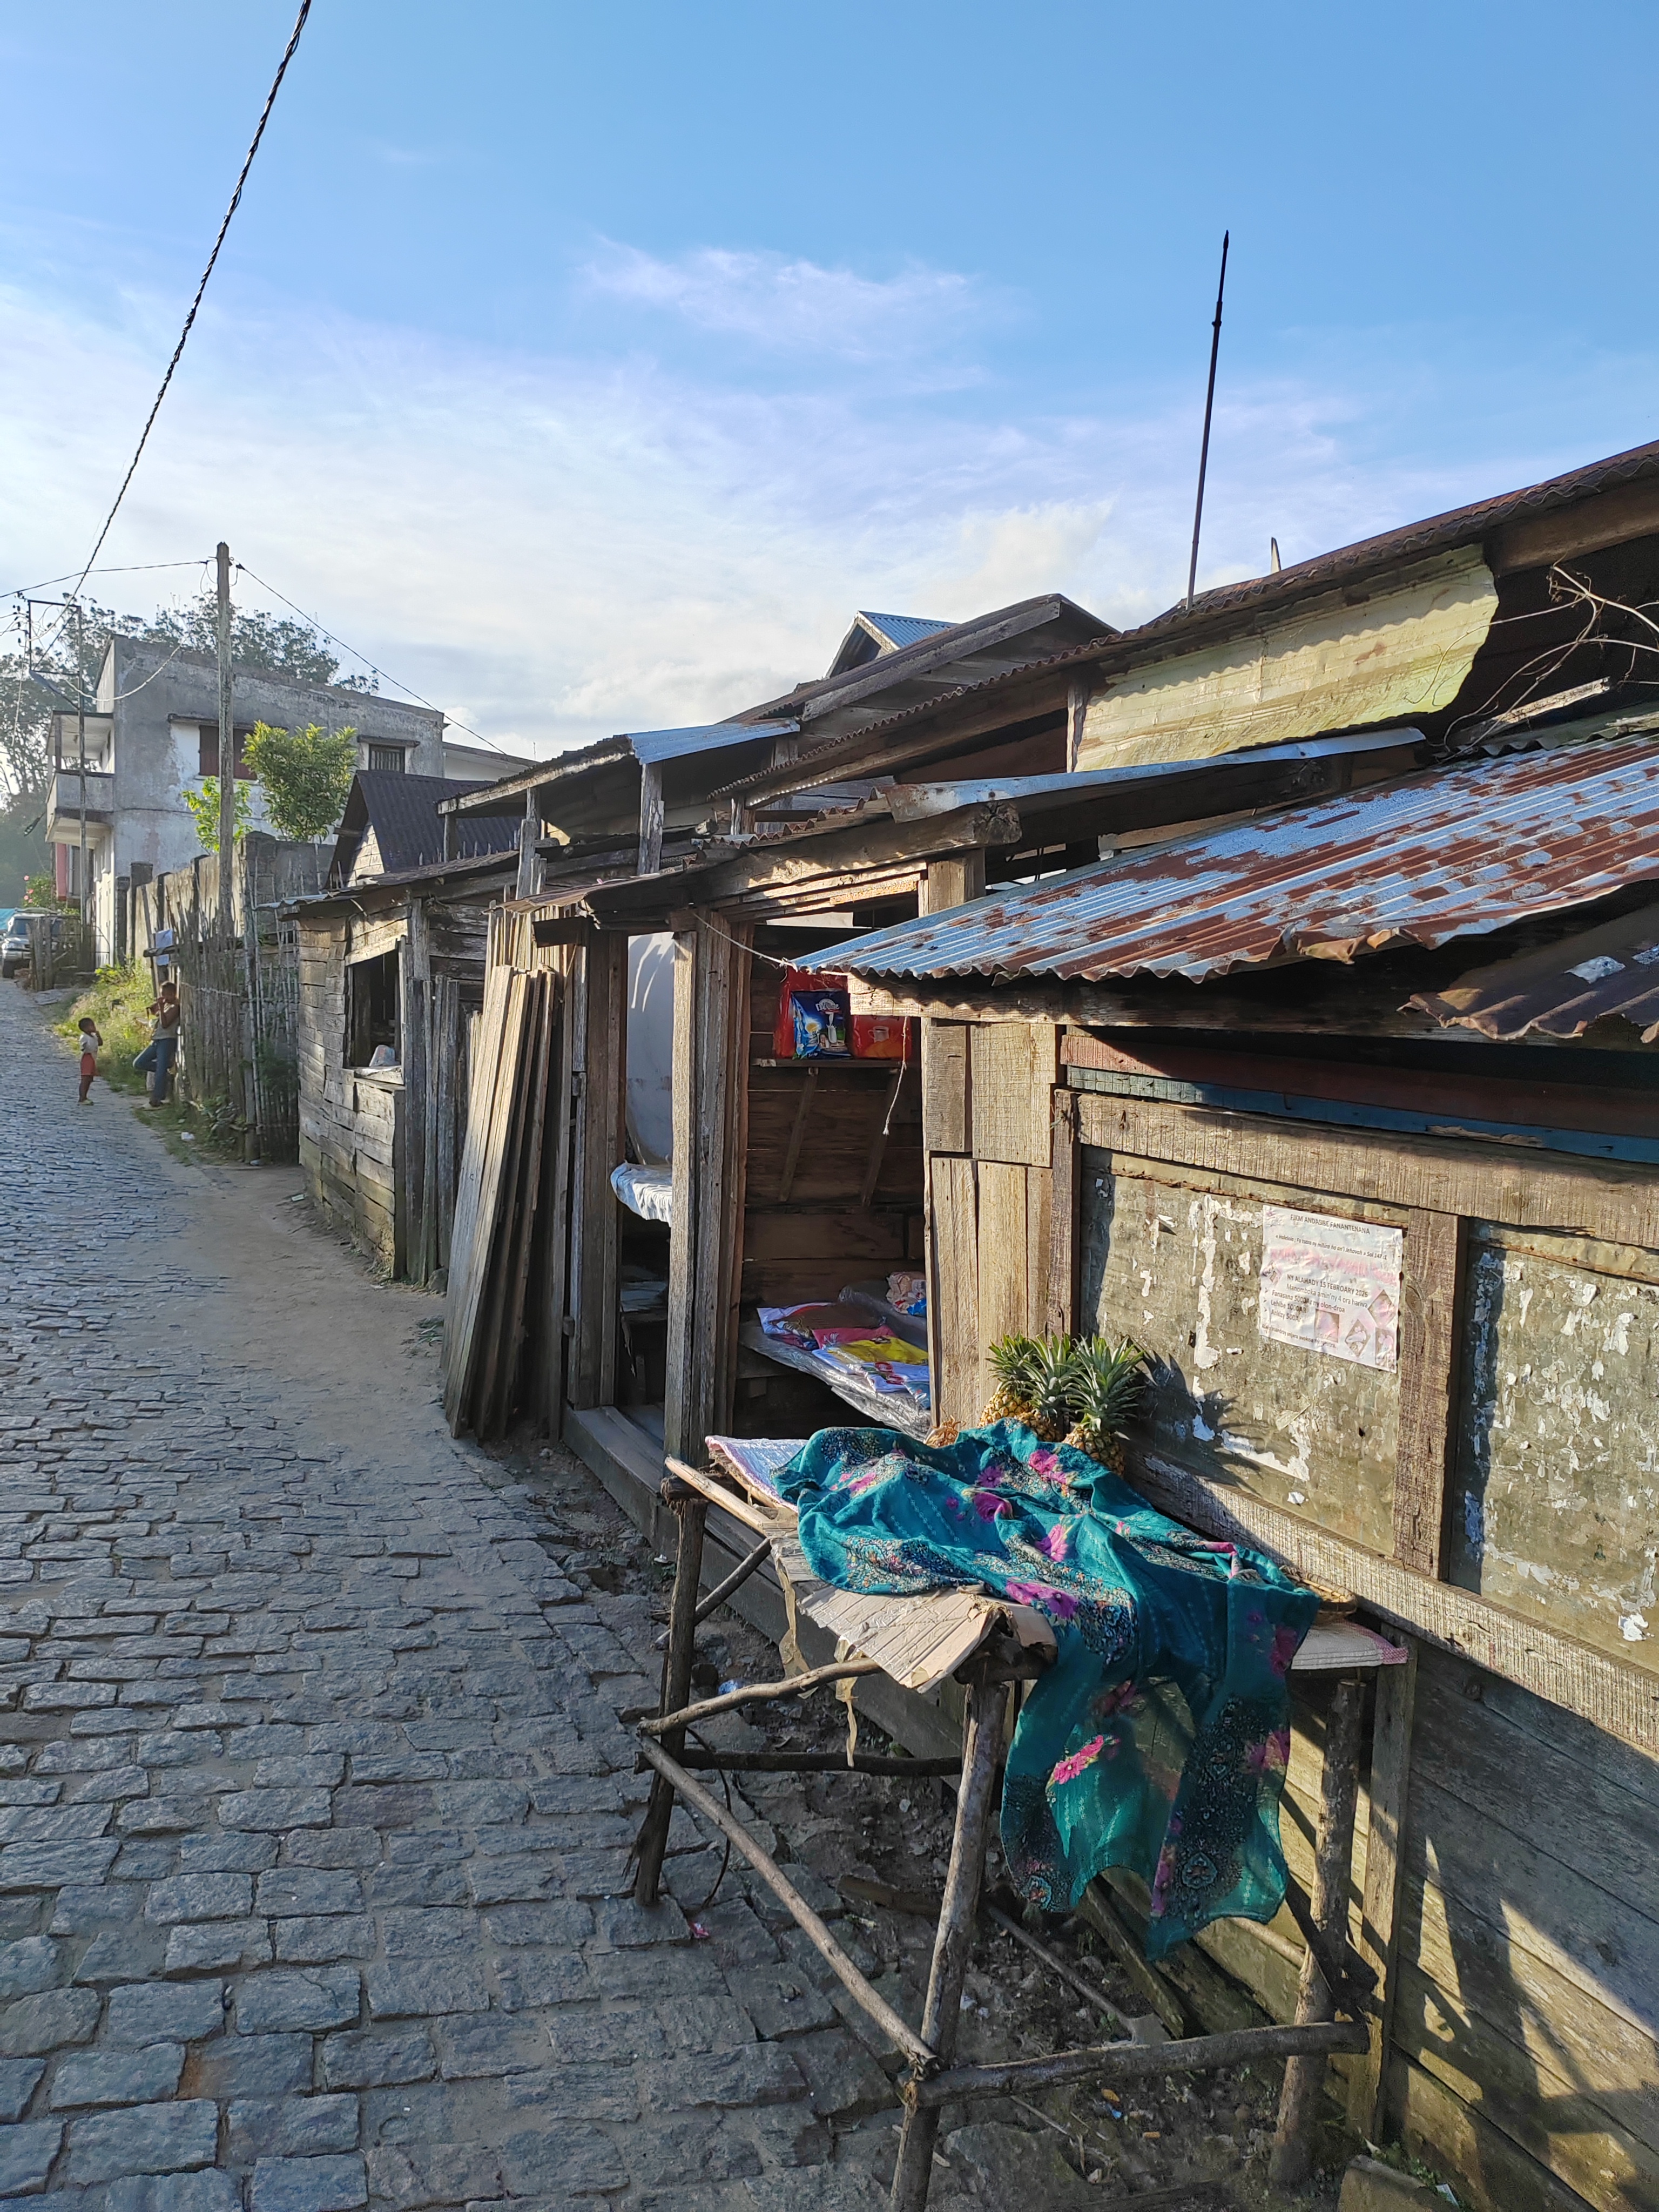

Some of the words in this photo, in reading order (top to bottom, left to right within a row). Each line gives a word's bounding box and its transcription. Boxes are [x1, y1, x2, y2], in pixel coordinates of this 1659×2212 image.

[1304, 1217, 1328, 1226] ANDASIBE
[1330, 1222, 1370, 1234] FANANTENANA
[1295, 1276, 1319, 1286] ALAHADY
[1327, 1283, 1354, 1294] FEBROARY
[1271, 1290, 1293, 1300] Fanasana
[1320, 1302, 1345, 1313] olon-droa
[1271, 1299, 1286, 1309] Lehibe
[1286, 1284, 1316, 1296] Manomboka
[1352, 1298, 1368, 1308] hariva
